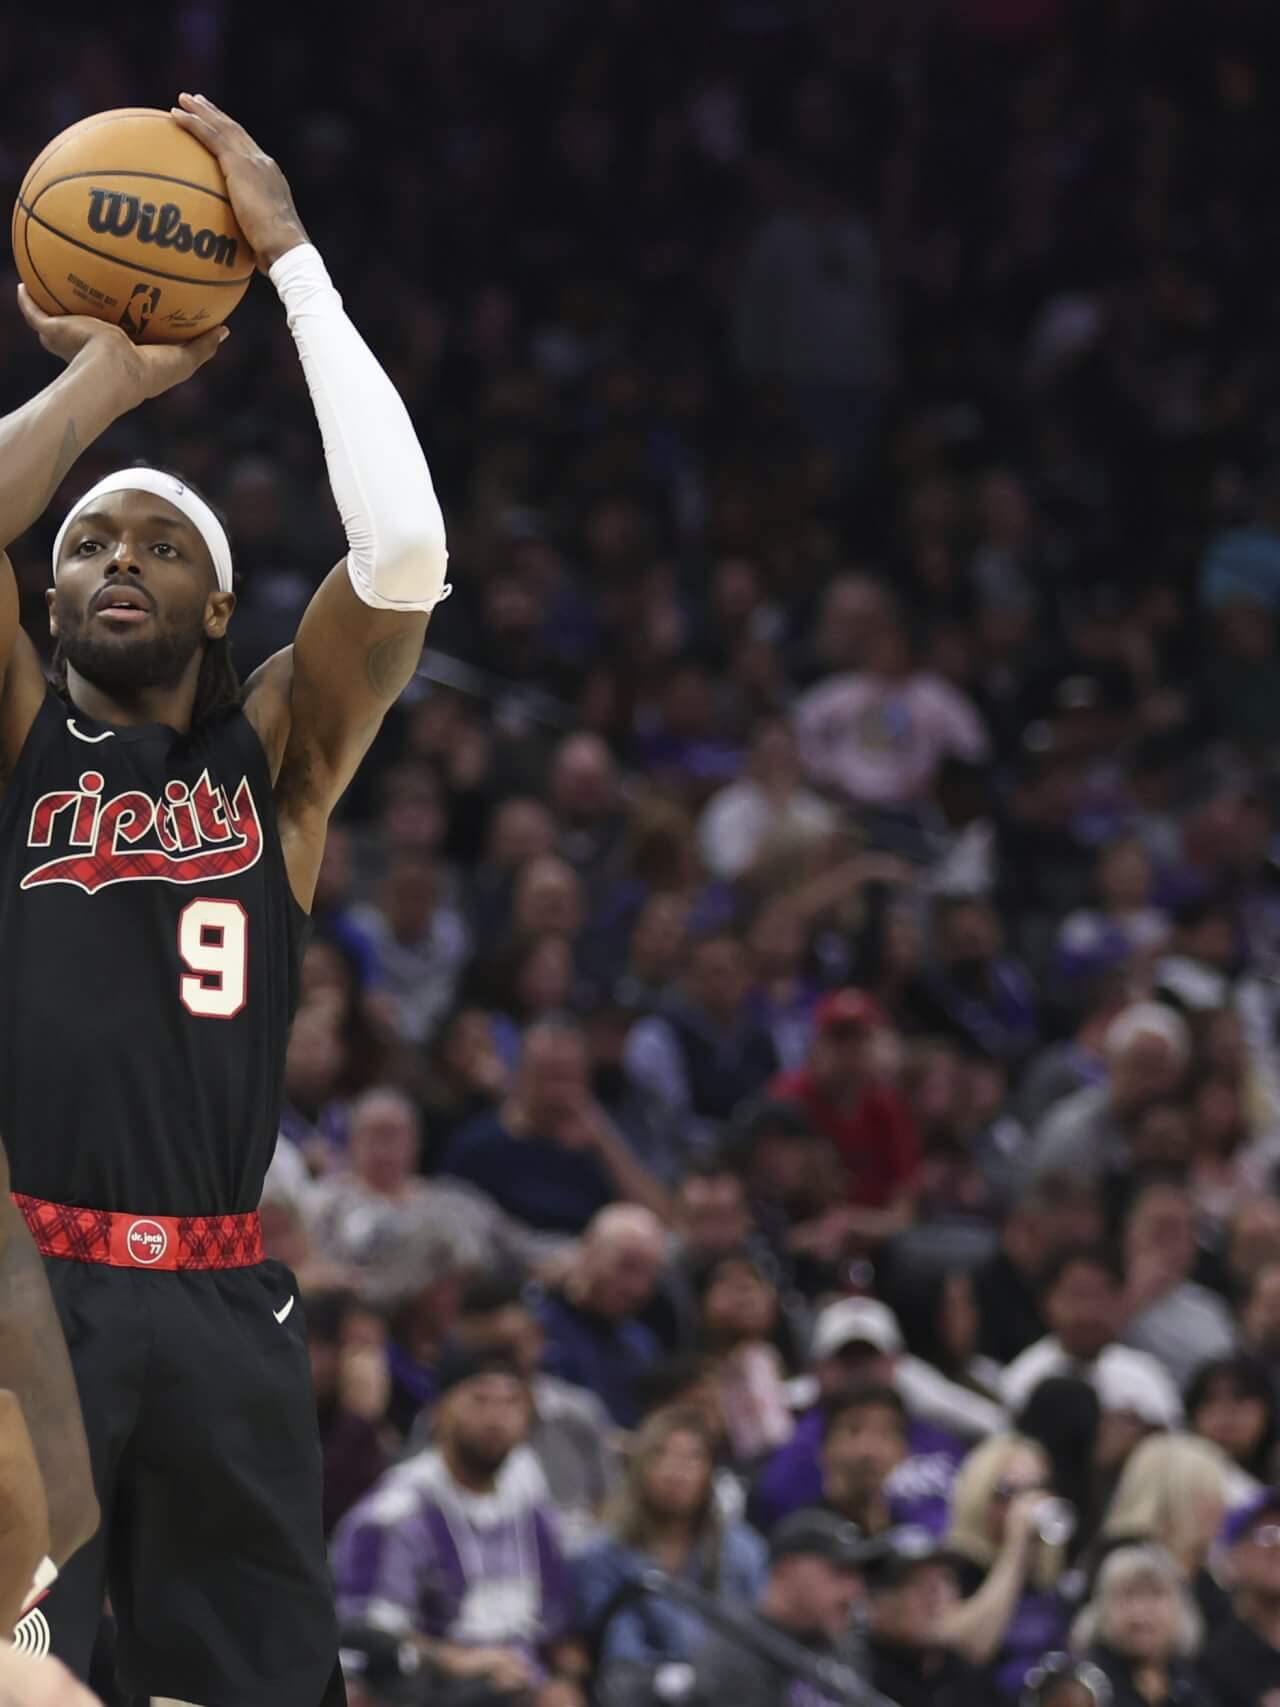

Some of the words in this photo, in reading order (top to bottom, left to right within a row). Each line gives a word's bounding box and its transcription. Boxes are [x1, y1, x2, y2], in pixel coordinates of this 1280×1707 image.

[87, 190, 237, 267] Wilson
[177, 897, 248, 1019] 9
[142, 1232, 162, 1244] jack
[150, 1244, 161, 1254] 77
